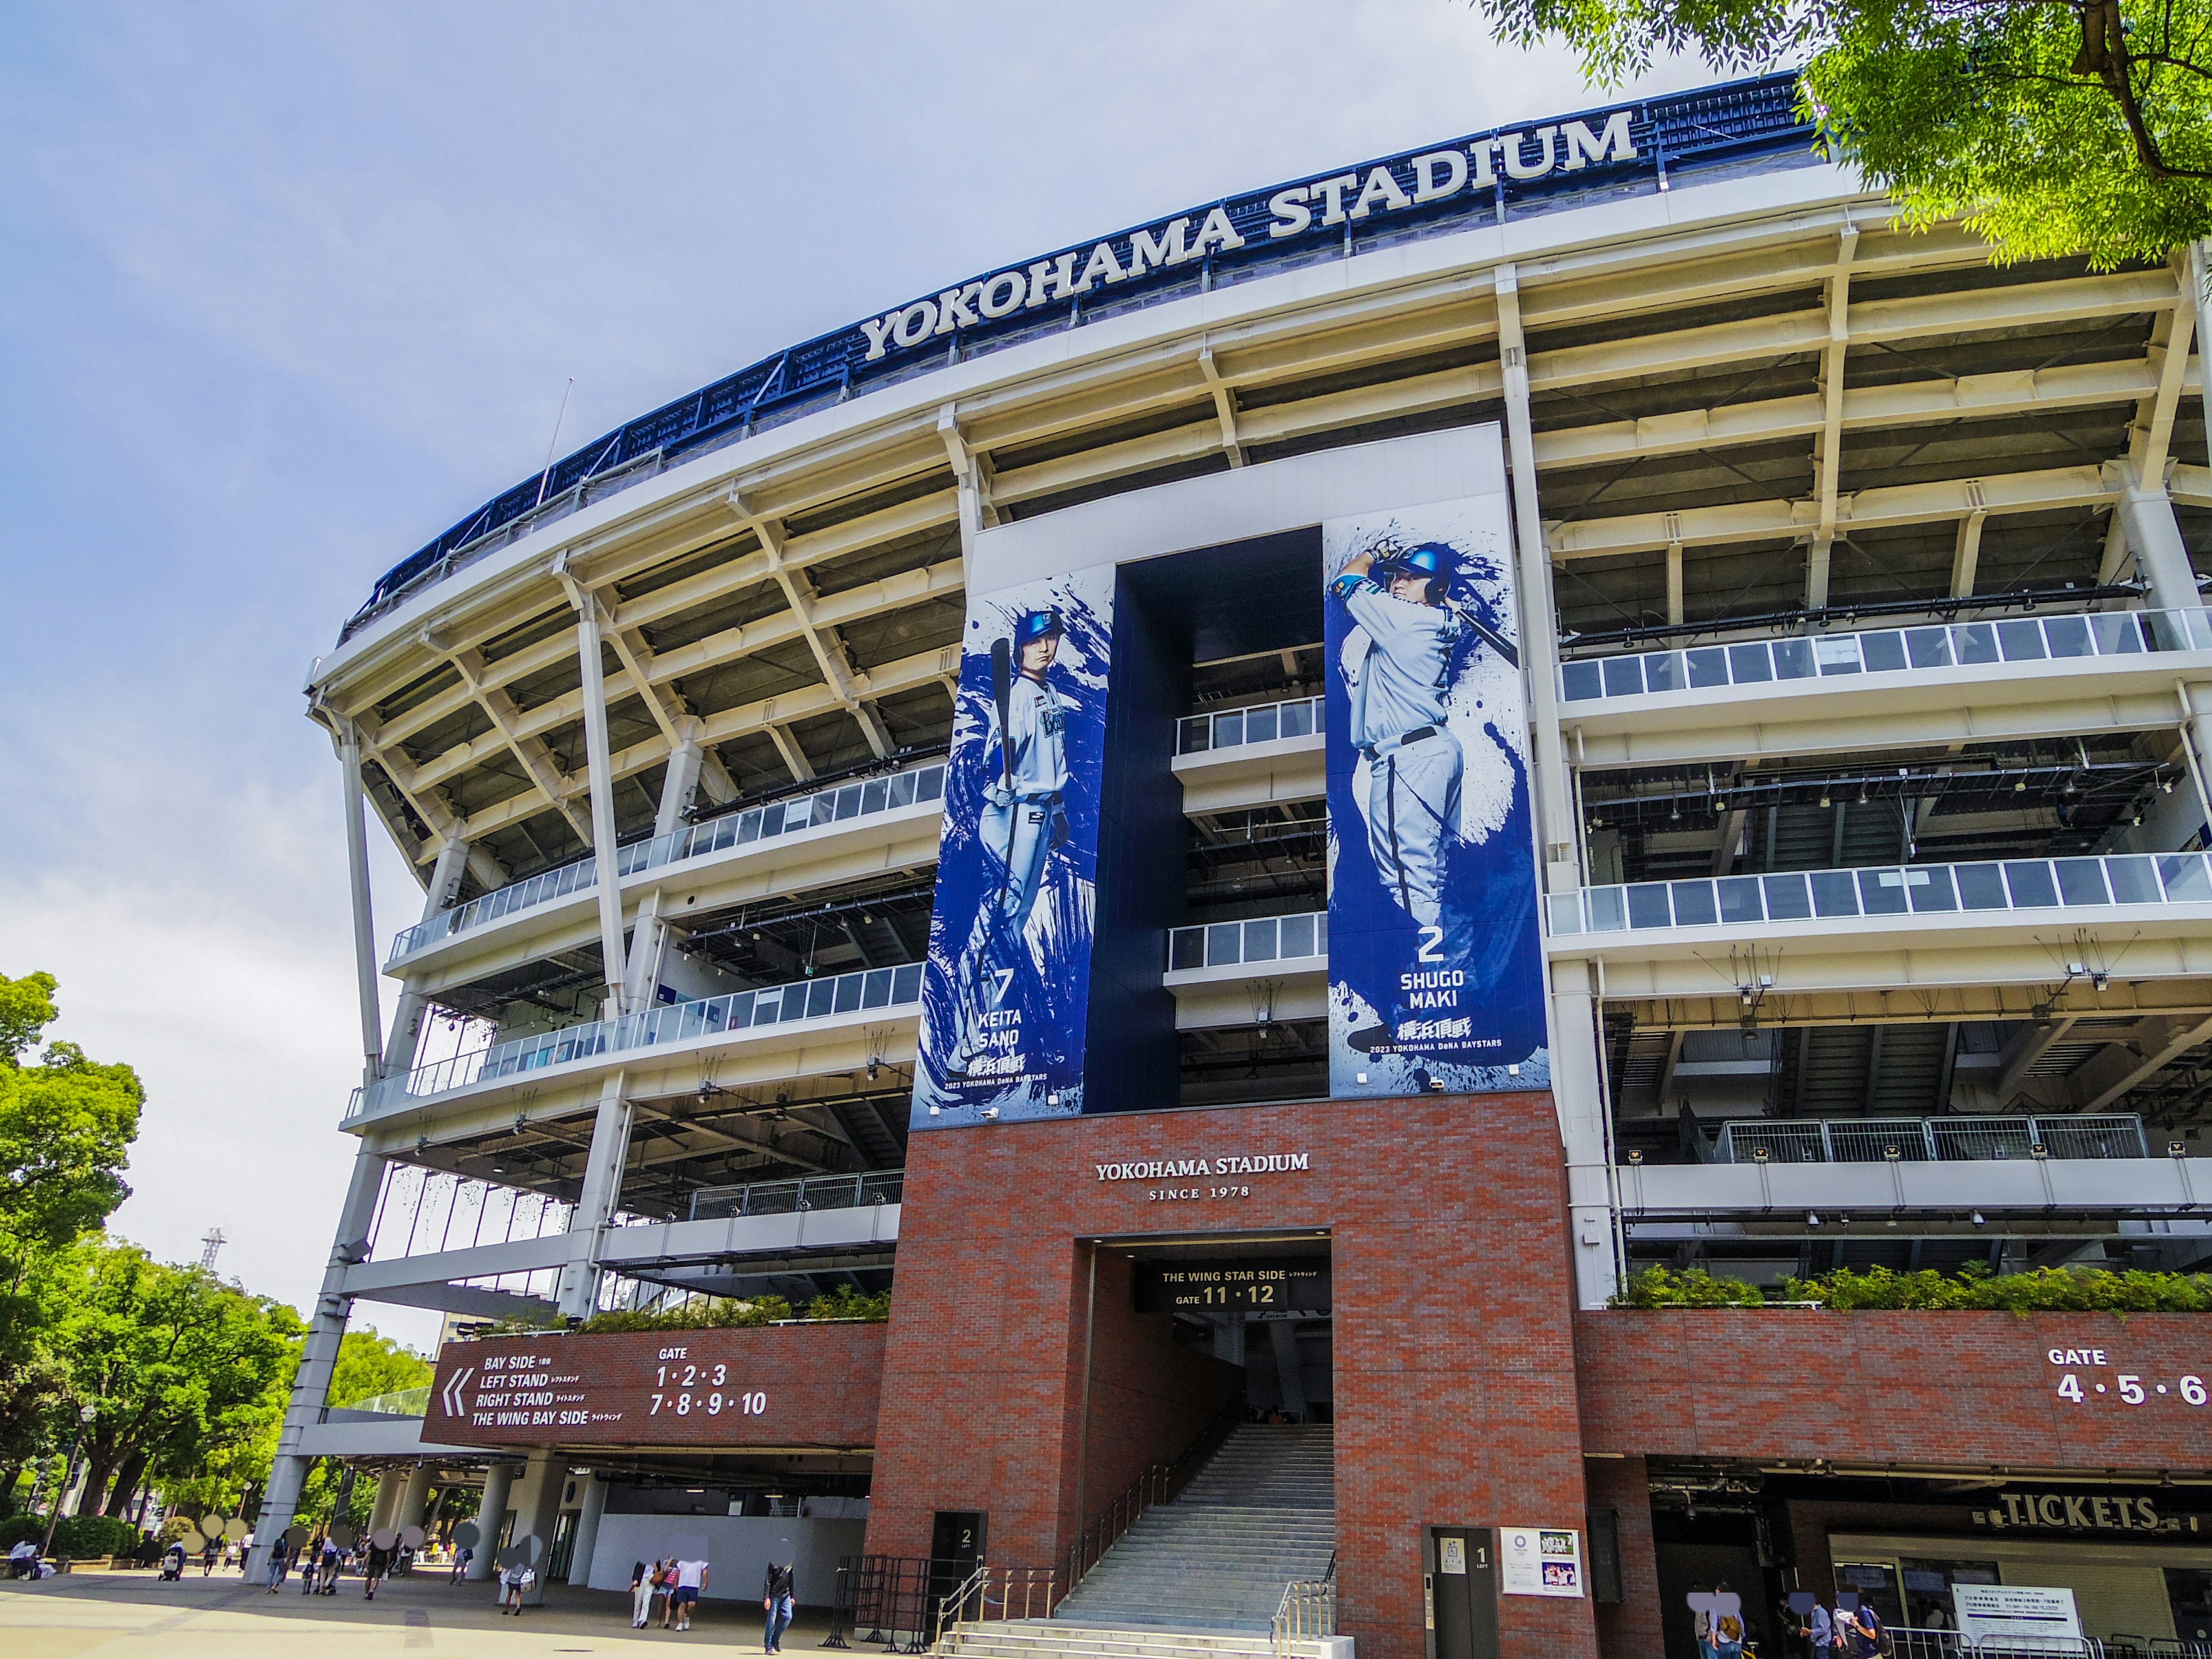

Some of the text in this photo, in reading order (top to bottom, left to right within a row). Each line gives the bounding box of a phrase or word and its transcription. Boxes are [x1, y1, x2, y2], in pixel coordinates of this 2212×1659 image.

[860, 111, 1638, 361] YOKOHAMA STADIUM
[1418, 926, 1444, 963] 2
[994, 968, 1014, 1003] 7
[1400, 970, 1464, 990] SHUGO
[1410, 990, 1457, 1009] MAKI
[978, 1009, 1022, 1028] KEITA
[979, 1029, 1019, 1048] SANO
[1370, 1046, 1390, 1054] 2023
[1392, 1043, 1435, 1052] YOKOHAMA
[1461, 1039, 1502, 1049] BAYSTARS
[944, 1073, 1047, 1090] 2023 YOKOHAMA DeNA BAYSTARS
[1096, 1153, 1309, 1181] YOKOHAMA STADIUM
[1149, 1186, 1249, 1200] SINCE 1978
[1162, 1272, 1184, 1282] THE
[1188, 1271, 1221, 1282] WING
[1225, 1271, 1255, 1281] STAR
[1258, 1270, 1286, 1280] SIDE
[1176, 1296, 1200, 1304] GATE
[659, 1347, 687, 1360] GATE
[2048, 1349, 2107, 1365] GATE
[484, 1357, 507, 1370] BAY
[509, 1355, 536, 1369] SIDE
[480, 1375, 507, 1389] LEFT
[509, 1373, 548, 1388] STAND
[476, 1393, 512, 1407] RIGHT
[513, 1392, 554, 1406] STAND
[472, 1412, 494, 1426] THE
[497, 1412, 529, 1425] WING
[532, 1411, 557, 1425] BAY
[559, 1411, 589, 1425] SIDE
[2001, 1494, 2159, 1529] TICKETS
[961, 1529, 971, 1543] 2
[1477, 1547, 1485, 1563] 1
